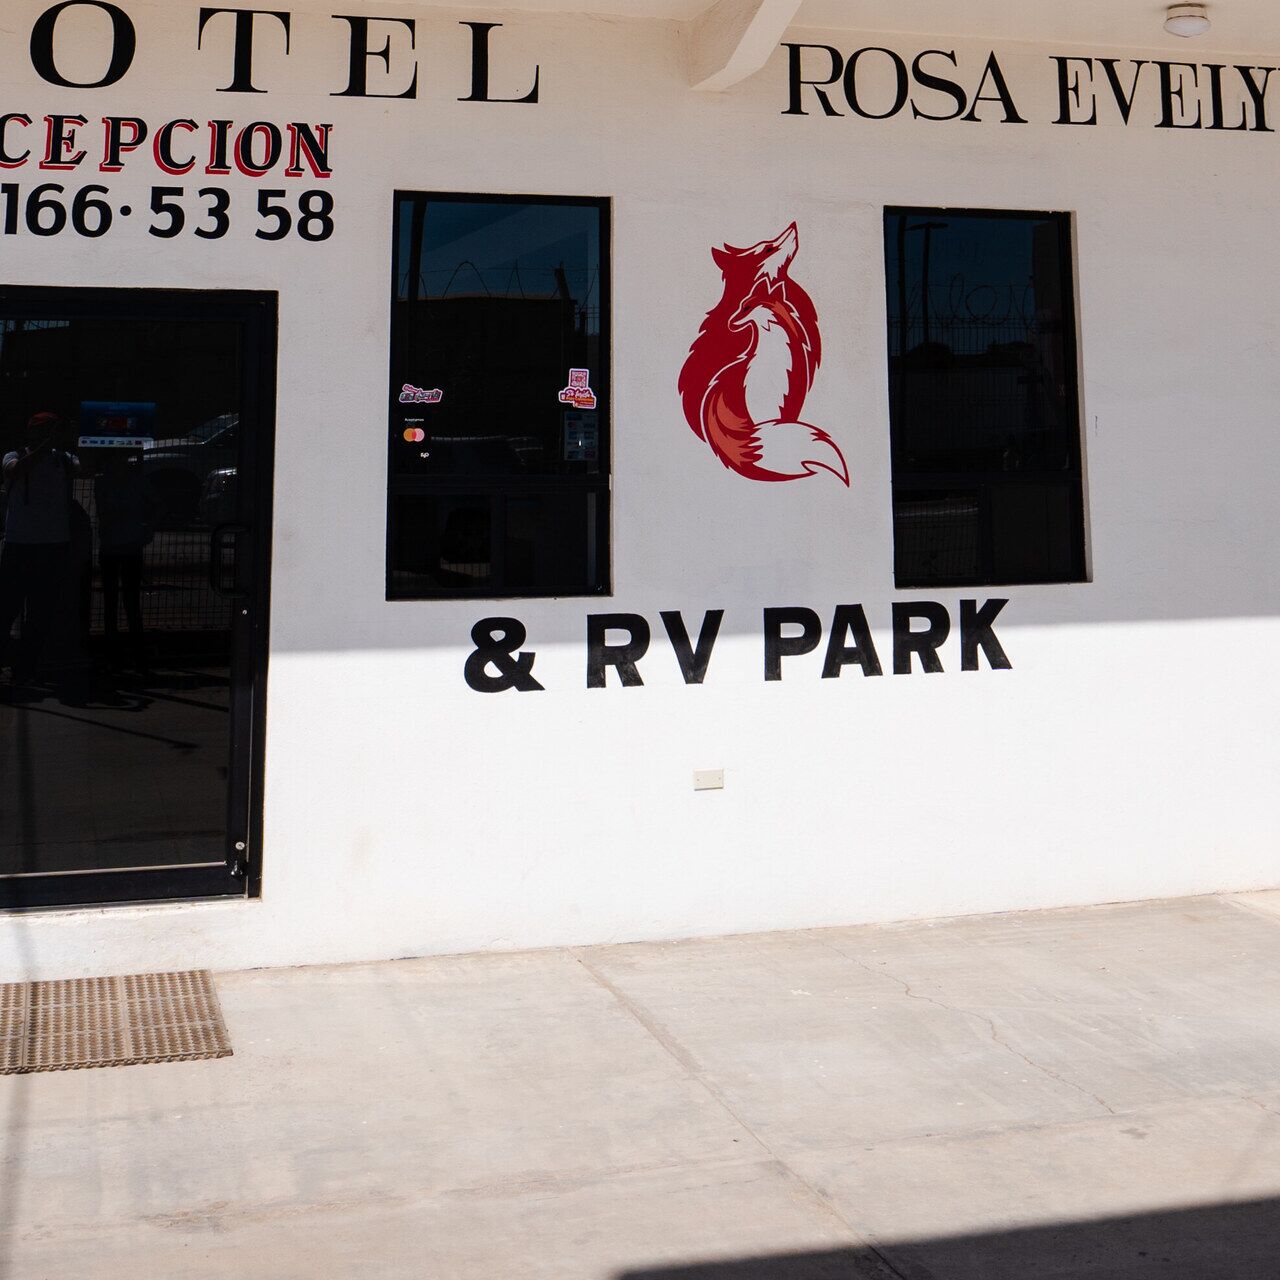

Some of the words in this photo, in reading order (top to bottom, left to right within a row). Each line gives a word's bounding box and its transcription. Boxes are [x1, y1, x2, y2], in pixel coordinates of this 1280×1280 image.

[780, 42, 1029, 124] ROSA
[254, 188, 335, 242] 58
[463, 616, 546, 694] &
[586, 608, 726, 689] RV
[763, 597, 1014, 682] PARK
